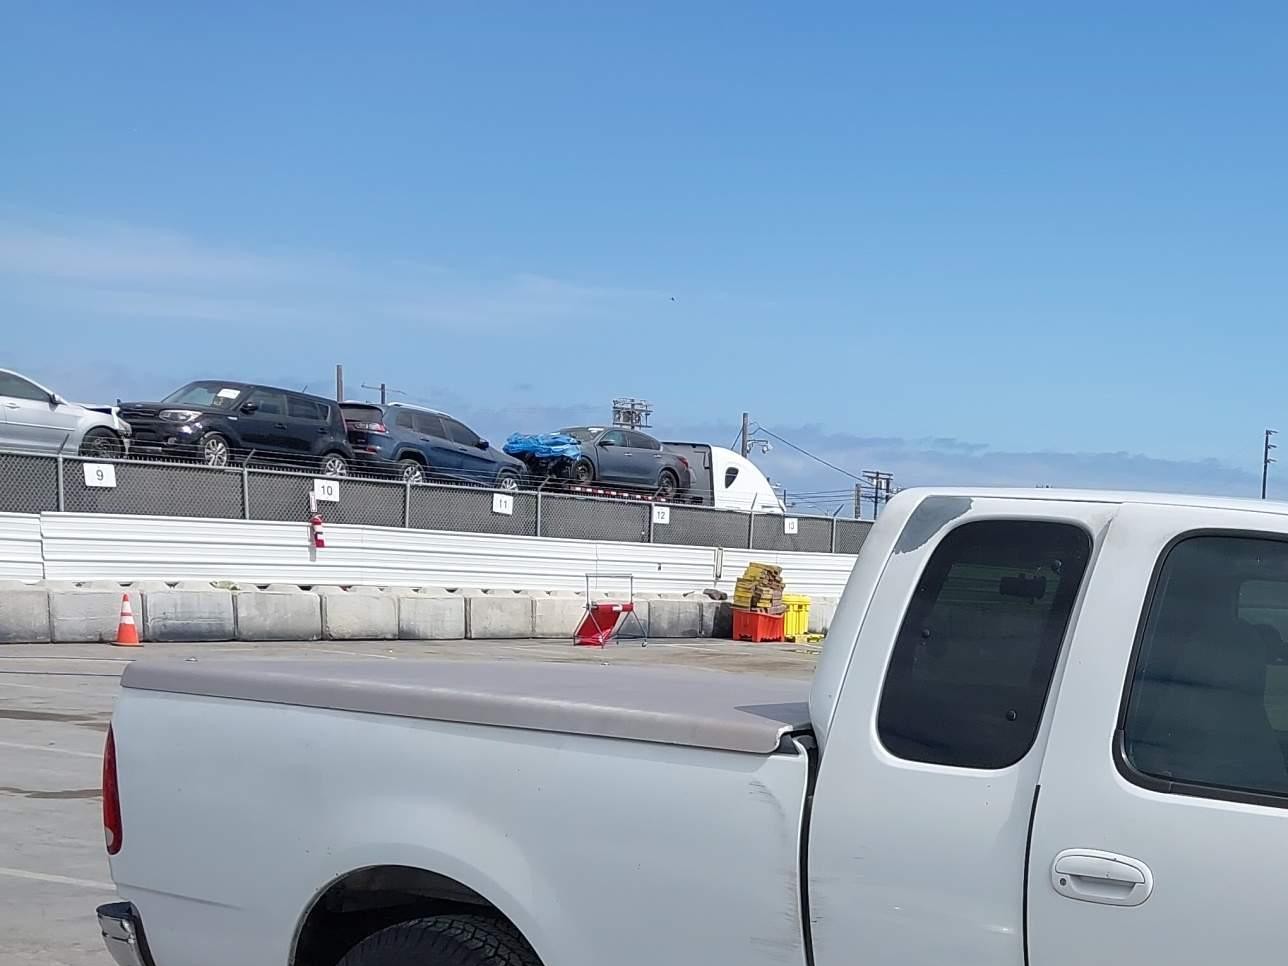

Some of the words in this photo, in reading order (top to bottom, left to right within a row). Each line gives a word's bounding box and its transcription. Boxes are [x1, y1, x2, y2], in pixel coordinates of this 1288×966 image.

[96, 469, 104, 481] 9
[321, 485, 333, 496] 10
[499, 499, 508, 509] 11
[657, 511, 666, 520] 12
